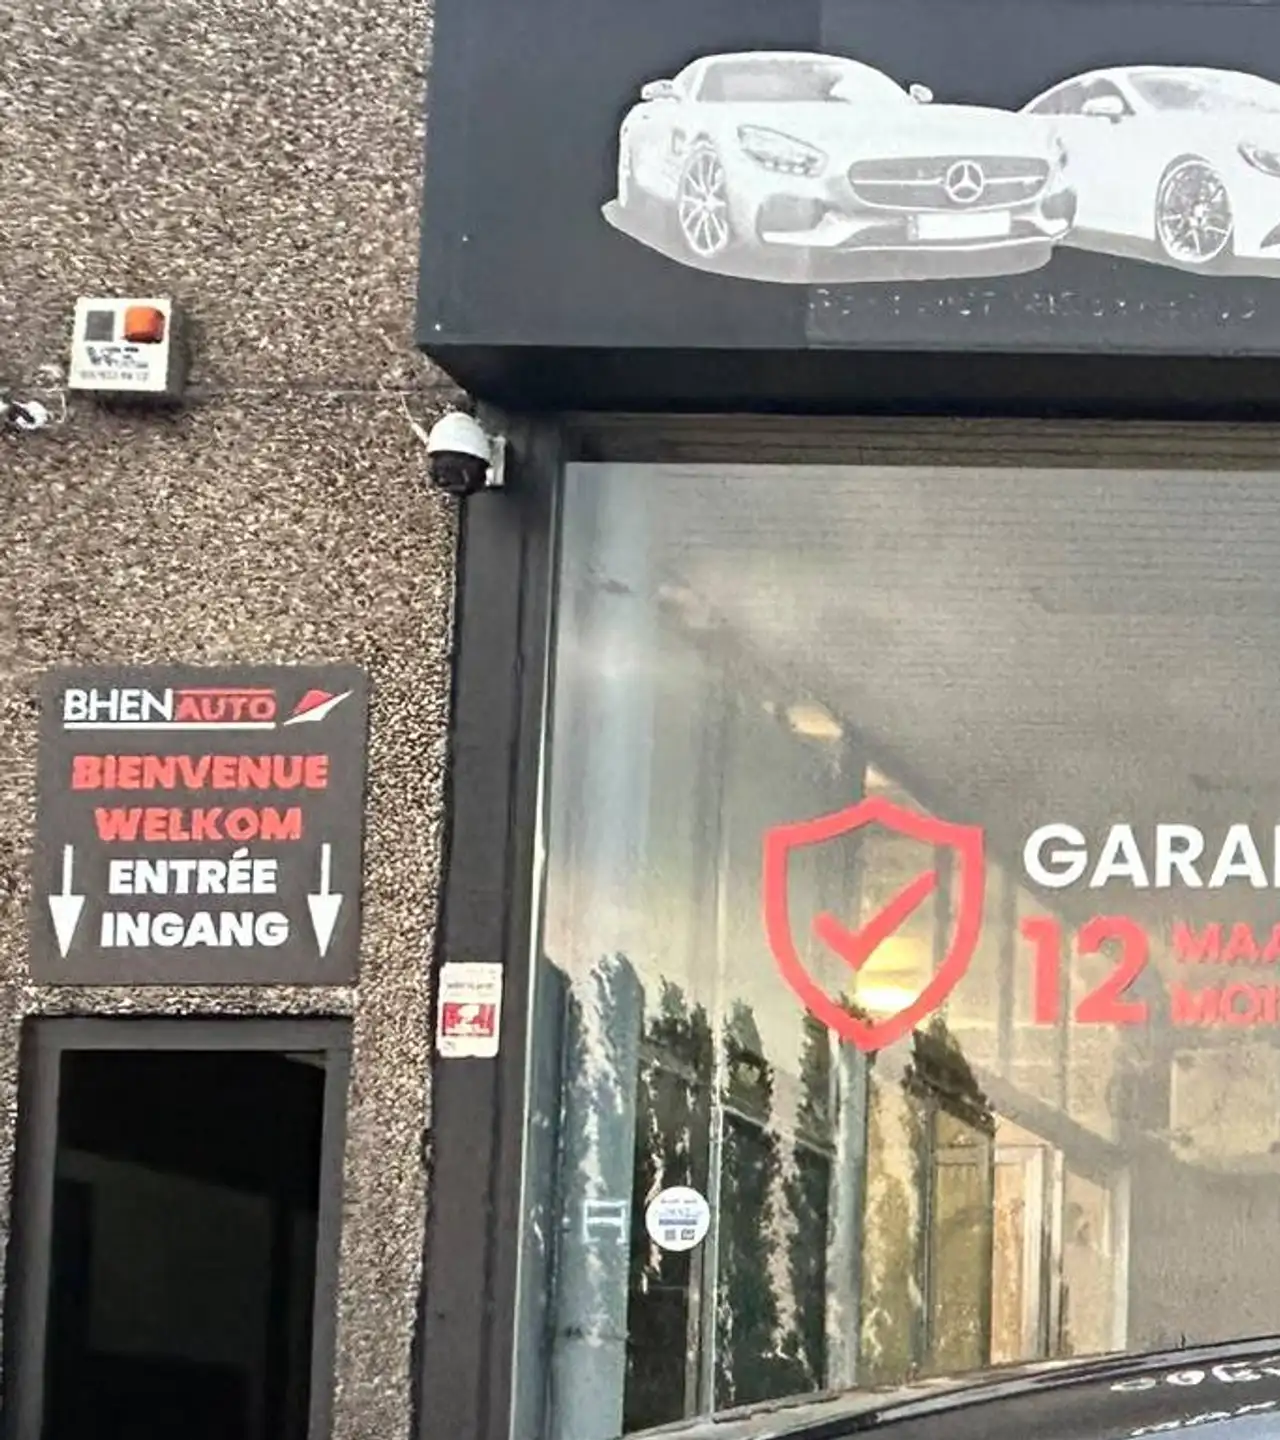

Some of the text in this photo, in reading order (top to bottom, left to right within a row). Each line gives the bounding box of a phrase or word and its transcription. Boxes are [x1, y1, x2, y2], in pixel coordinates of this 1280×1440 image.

[71, 755, 330, 791] BIENVENUE
[94, 807, 304, 842] WELKOM
[108, 847, 278, 896] ENTRÉE
[100, 911, 290, 948] INGANG
[1021, 914, 1150, 1026] 12
